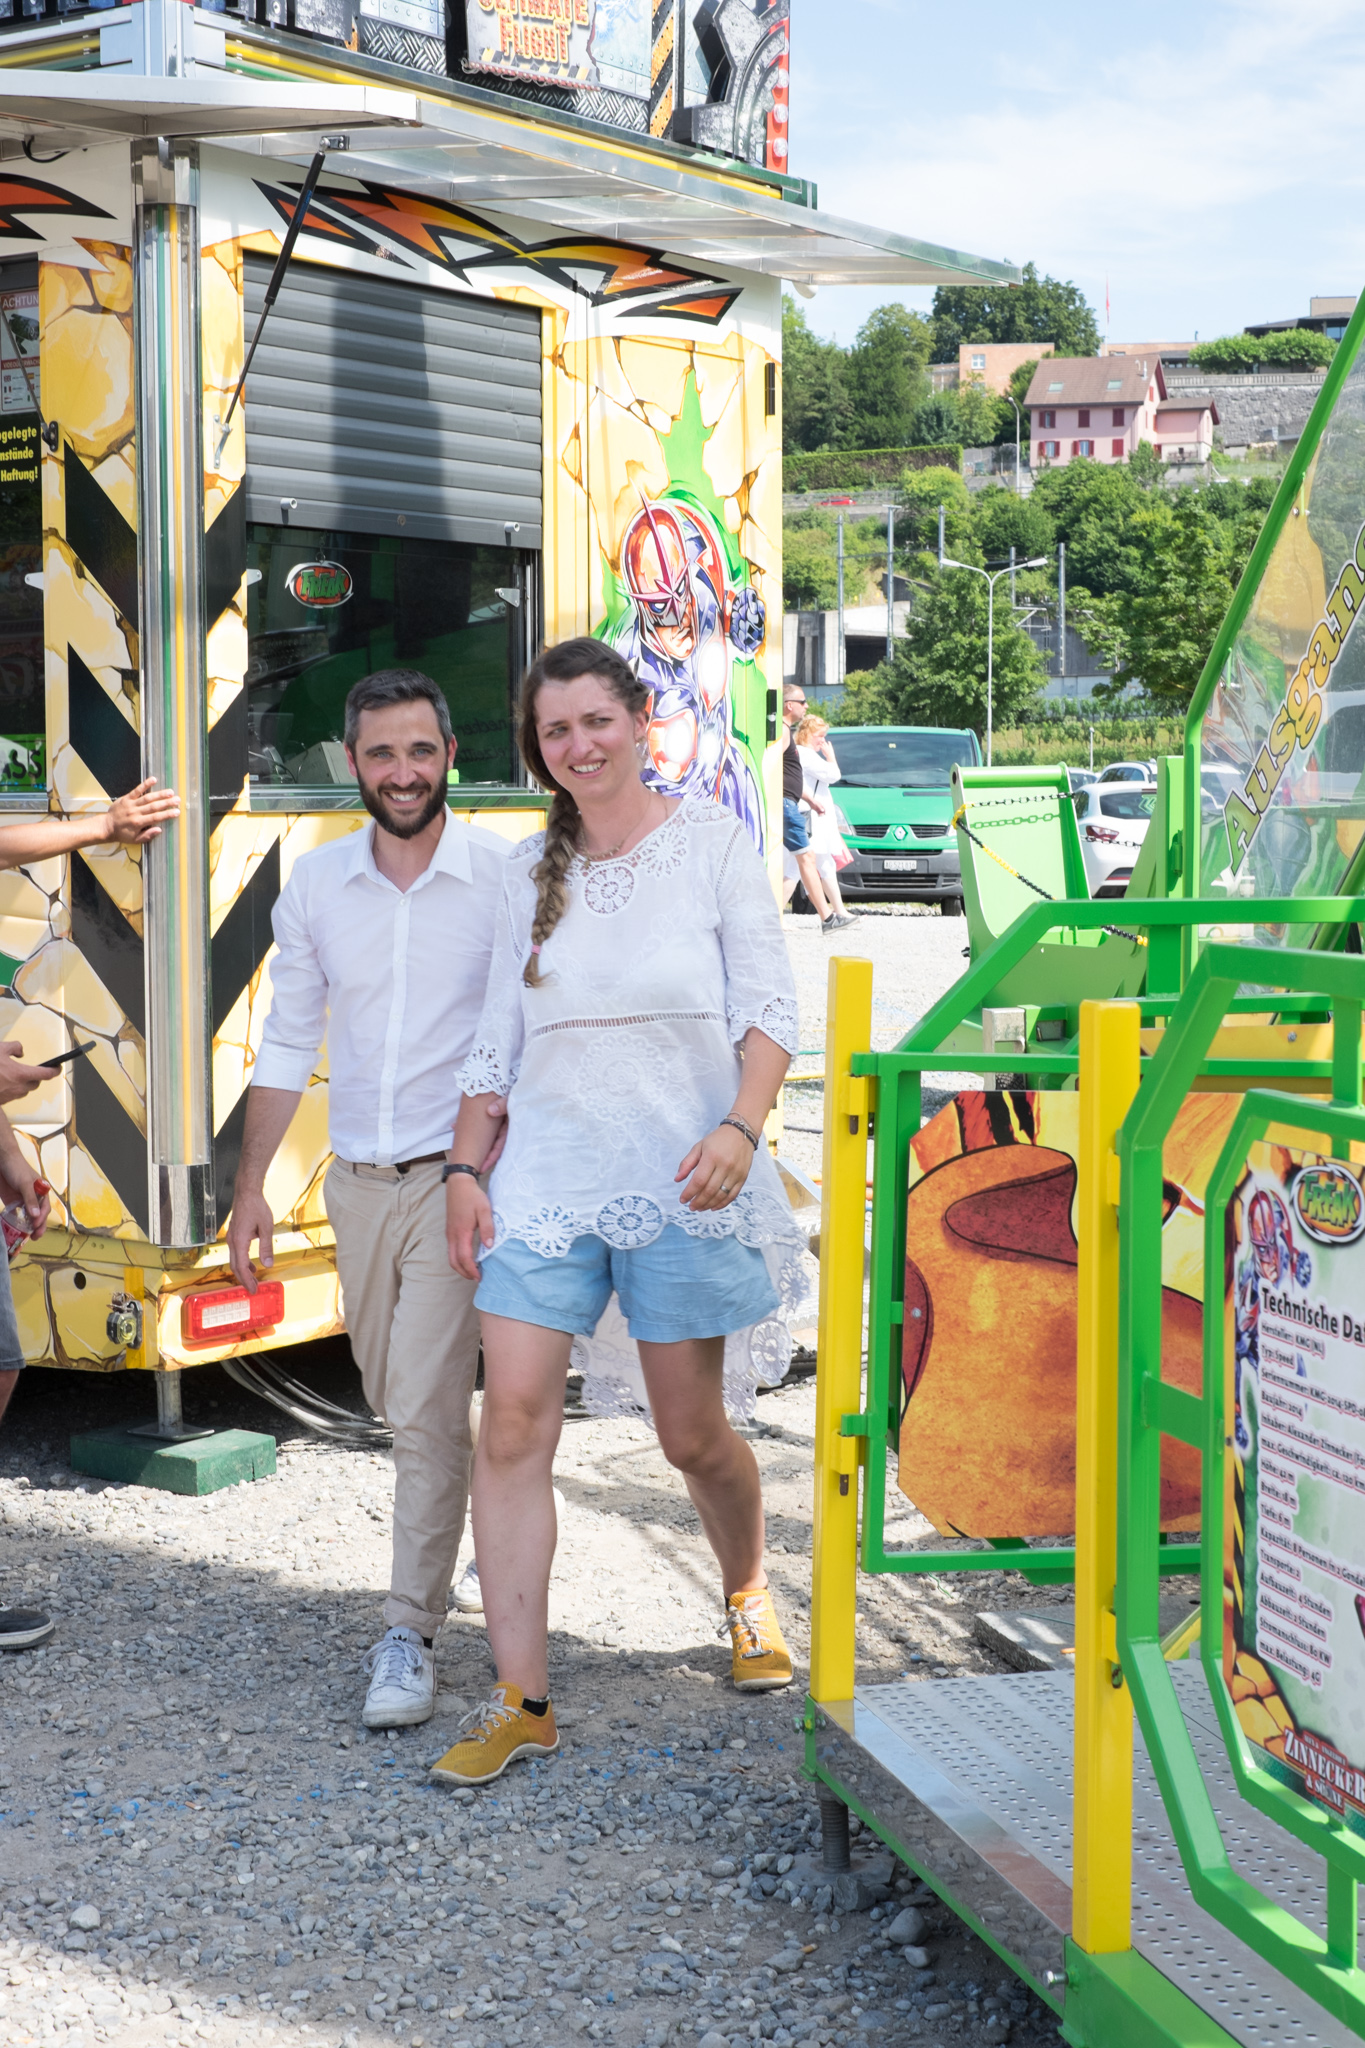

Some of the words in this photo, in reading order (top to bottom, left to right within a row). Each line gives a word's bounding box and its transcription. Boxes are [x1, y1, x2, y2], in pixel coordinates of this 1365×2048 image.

[499, 13, 571, 63] FLIGHT
[0, 426, 37, 444] gelegte
[1, 466, 38, 482] Haftung!
[300, 569, 347, 599] FREAK
[1302, 1173, 1357, 1228] FREAK
[1262, 1287, 1337, 1334] Technische
[1343, 1315, 1365, 1343] Da
[1296, 1335, 1310, 1348] KMG
[1276, 1350, 1294, 1366] Speed
[1262, 1368, 1309, 1394] Seriennummer:
[1262, 1390, 1287, 1409] Baujahr:
[1289, 1404, 1302, 1416] 2014
[1262, 1415, 1287, 1431] Inhaber:
[1288, 1425, 1319, 1445] Alexander
[1321, 1439, 1352, 1460] Zinnecker
[1261, 1459, 1279, 1474] Höhe:
[1262, 1438, 1276, 1451] max.
[1278, 1444, 1330, 1475] Geschwindigkeit:
[1261, 1481, 1281, 1499] Breite:
[1261, 1504, 1277, 1520] Tiefe:
[1261, 1527, 1292, 1551] Kapazität:
[1299, 1545, 1327, 1568] Personen
[1261, 1549, 1295, 1575] Transporte:
[1261, 1572, 1296, 1598] Aufbauzeit:
[1304, 1595, 1331, 1617] Stunden
[1261, 1595, 1293, 1620] Abbauzeit:
[1299, 1615, 1326, 1638] Stunden
[1260, 1617, 1309, 1652] Stromanschluss:
[1260, 1641, 1275, 1655] max.
[1276, 1649, 1309, 1677] Belastung:
[1284, 1728, 1365, 1804] ZINNECKER
